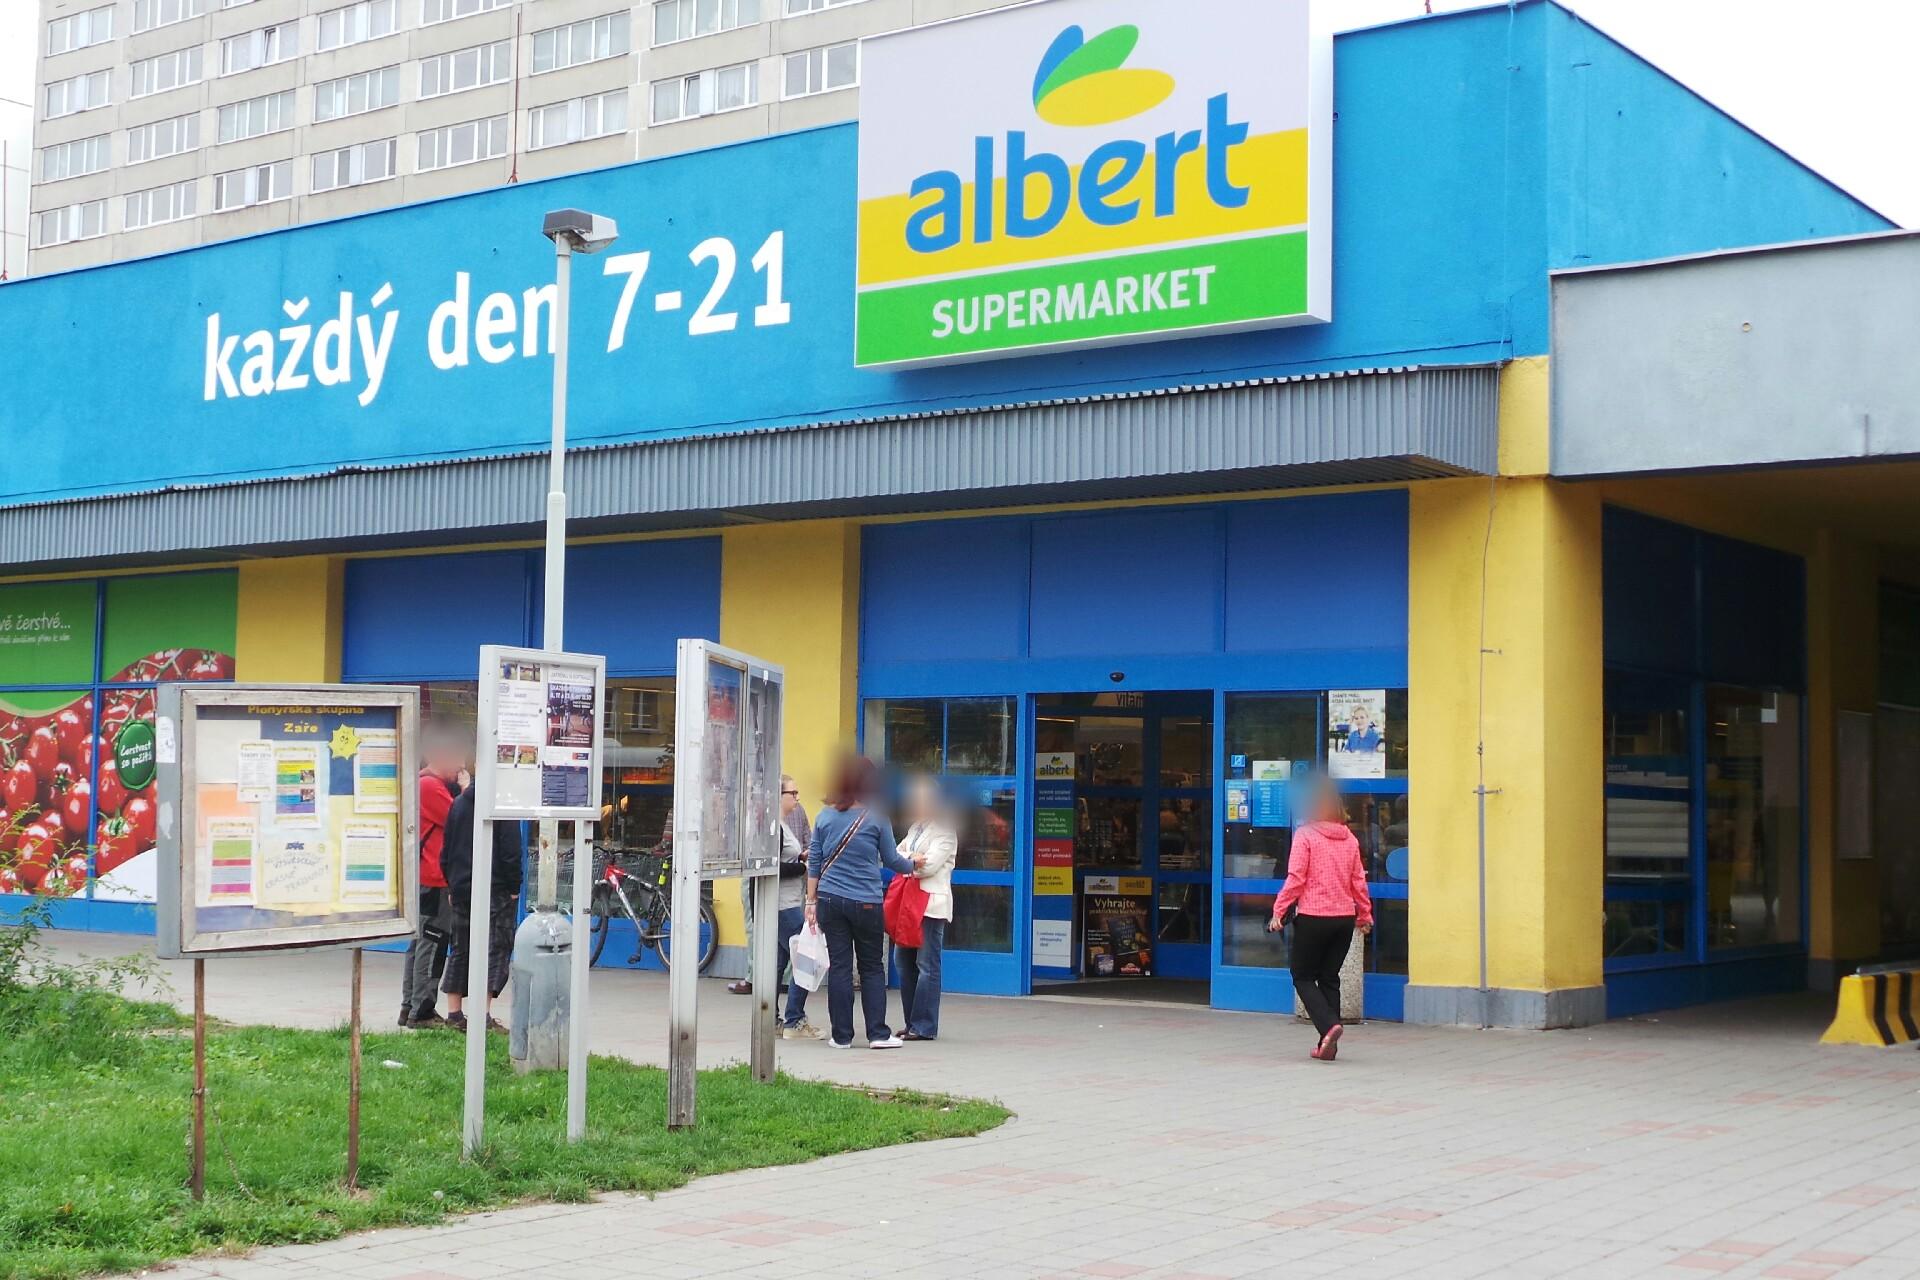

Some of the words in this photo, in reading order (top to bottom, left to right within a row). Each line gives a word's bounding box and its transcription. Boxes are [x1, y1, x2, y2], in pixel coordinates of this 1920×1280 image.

[905, 92, 1249, 253] albert
[931, 265, 1216, 338] SUPERMARKET
[203, 282, 399, 407] každý
[428, 271, 557, 370] den
[1039, 764, 1070, 776] albert
[1094, 897, 1136, 910] Vyhrajte
